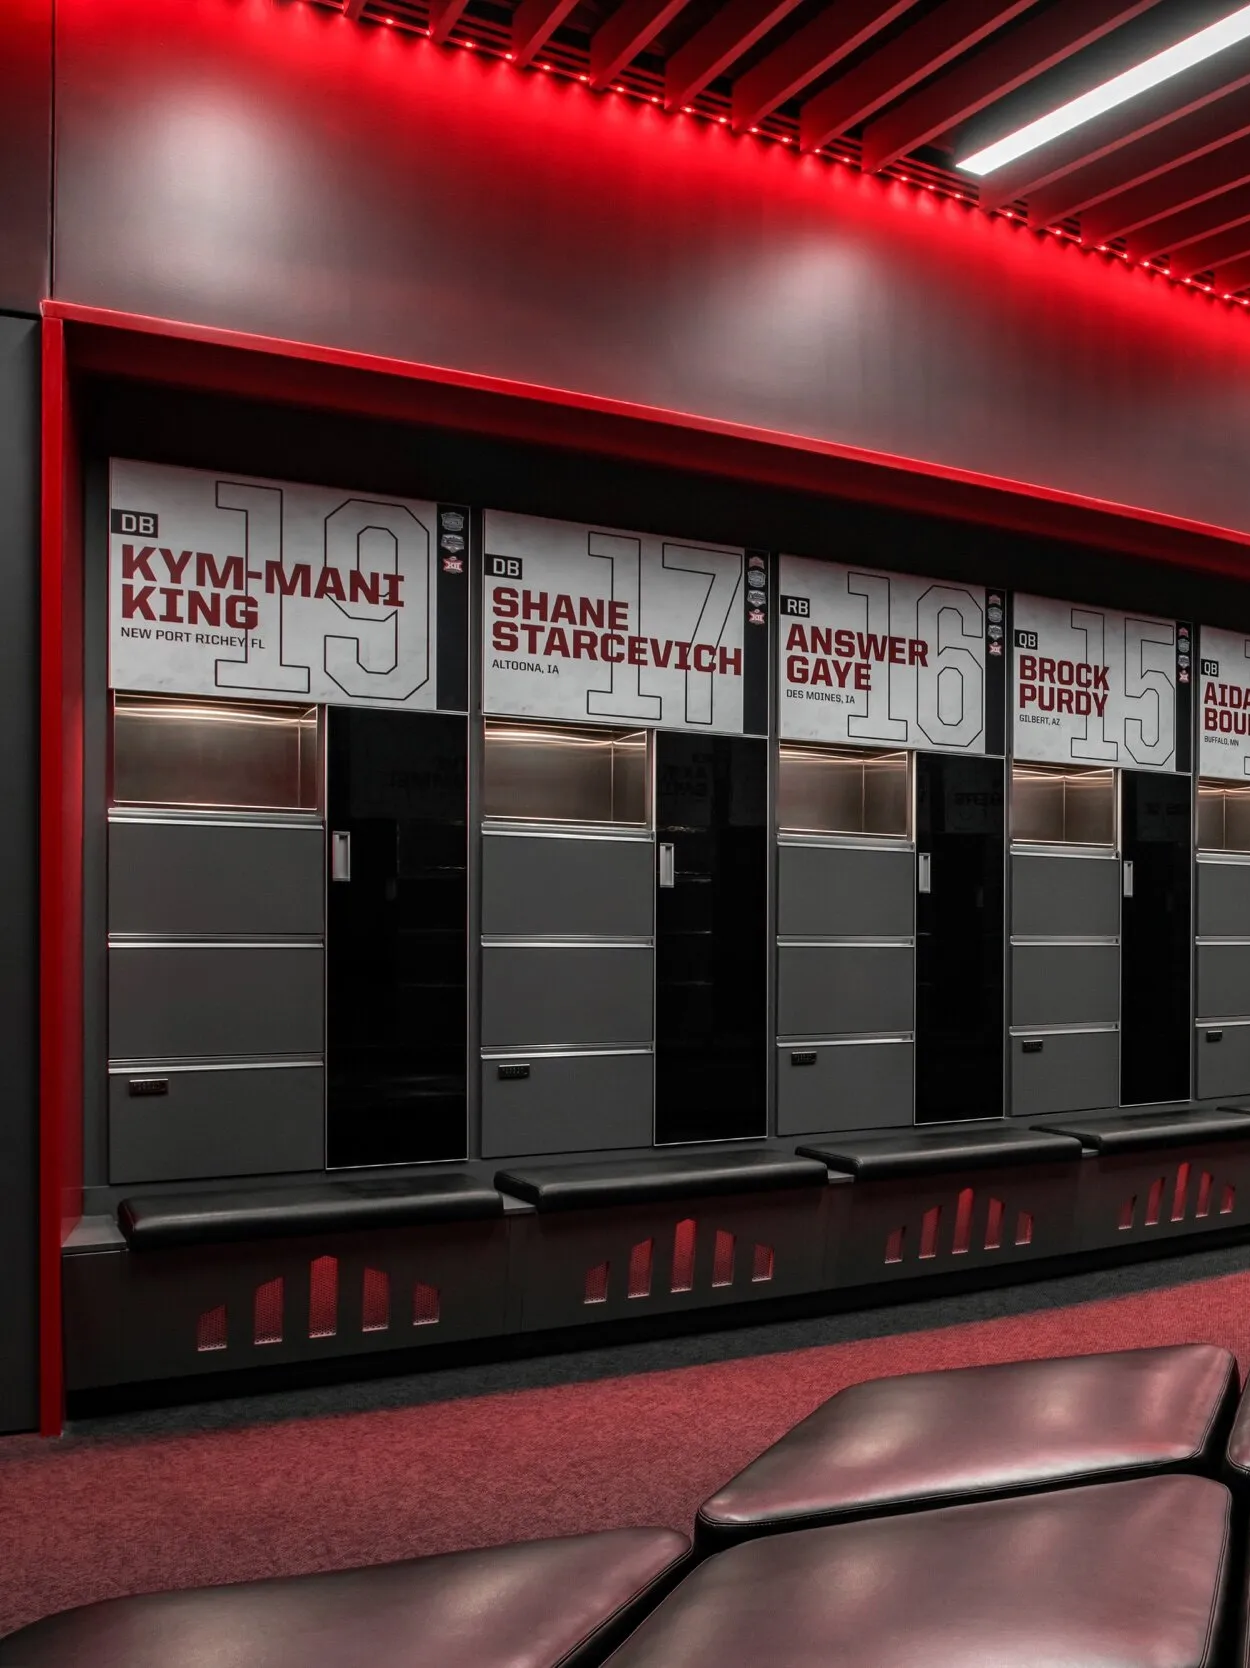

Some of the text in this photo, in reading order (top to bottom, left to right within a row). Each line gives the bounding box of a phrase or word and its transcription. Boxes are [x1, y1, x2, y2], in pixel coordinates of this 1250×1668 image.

[120, 513, 155, 534] DB
[121, 544, 405, 607] KYM-MANI
[493, 557, 520, 577] DB
[121, 583, 259, 630] KING
[216, 481, 430, 701] 19
[492, 586, 629, 631] SHANE
[787, 598, 809, 616] RB
[121, 627, 152, 639] NEW
[155, 629, 192, 643] PORT
[251, 638, 266, 649] FL
[587, 531, 743, 725] 17
[786, 623, 929, 667] ANSWER
[1019, 632, 1036, 649] QB
[492, 621, 742, 676] STARCEVICH
[848, 571, 983, 748] 16
[492, 659, 560, 675] ALTOONA, IA
[787, 655, 872, 691] GAYE
[1019, 654, 1110, 691] BROCK
[1204, 661, 1218, 676] QB
[786, 689, 856, 704] DES MOINES, IA
[1019, 683, 1109, 718] PURDY
[1071, 608, 1175, 766] 15
[1019, 714, 1061, 726] GILBERT, AZ
[1204, 736, 1229, 746] BUFFALO,
